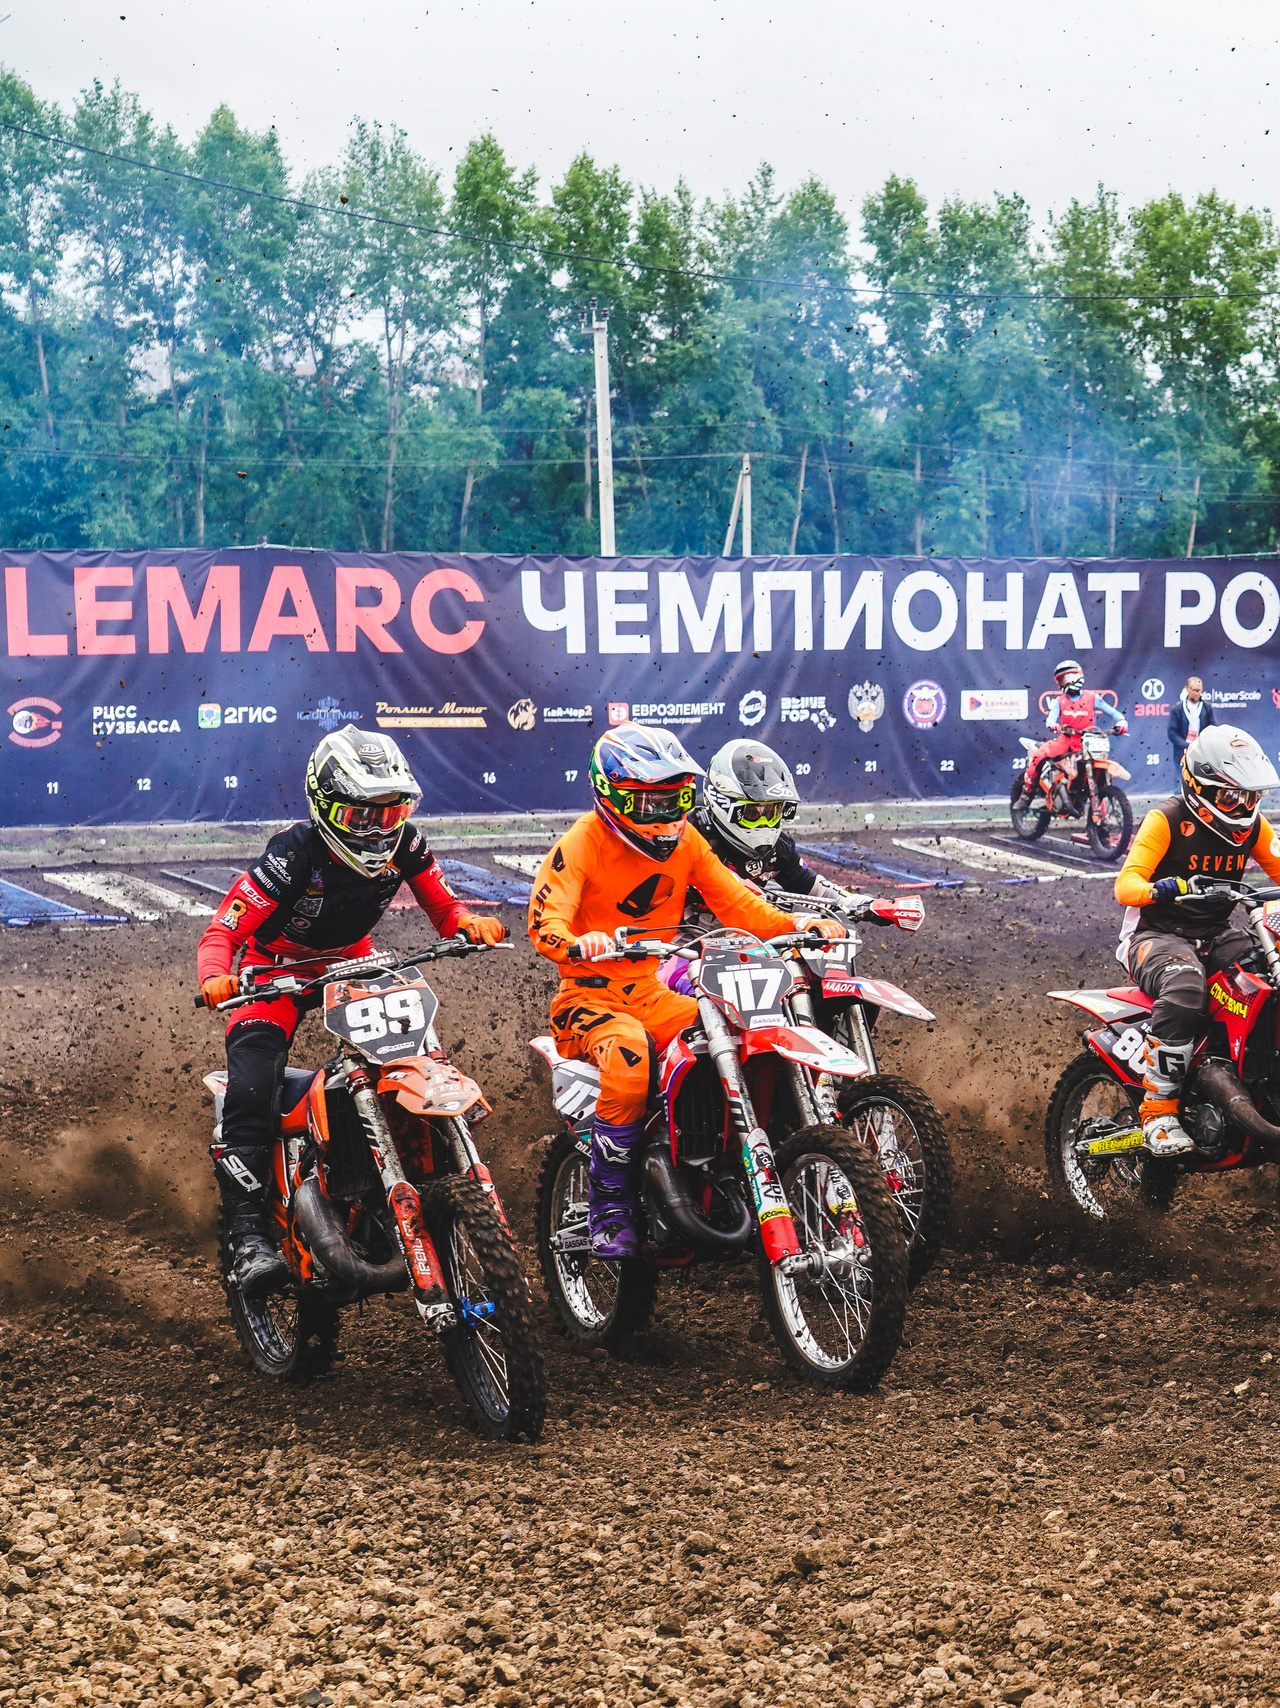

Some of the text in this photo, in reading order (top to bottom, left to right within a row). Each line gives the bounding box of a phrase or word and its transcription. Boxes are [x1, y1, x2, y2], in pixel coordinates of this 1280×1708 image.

[5, 566, 486, 656] LEMARC
[521, 570, 1140, 654] ЧЕМПИОНАТ
[93, 706, 137, 720] РЦСС
[224, 706, 277, 724] 2ГИС
[631, 702, 726, 717] ЕВРОЭЛЕМЕНТ
[1134, 703, 1170, 717] BAIC
[92, 720, 181, 735] КУЗБАССА
[940, 759, 955, 771] 22
[1012, 758, 1026, 769] 23
[1146, 754, 1159, 765] 25
[795, 763, 811, 775] 20
[864, 760, 877, 772] 21
[224, 776, 238, 788] 13
[483, 772, 497, 784] 16
[565, 770, 578, 782] 17
[47, 782, 59, 794] 11
[137, 778, 151, 790] 12
[1188, 854, 1245, 872] SEVEN
[331, 951, 392, 969] RENTHAL
[716, 968, 785, 1013] 117
[823, 981, 857, 993] ЛАДОГА
[345, 989, 426, 1044] 99
[565, 1238, 588, 1249] GASGAS
